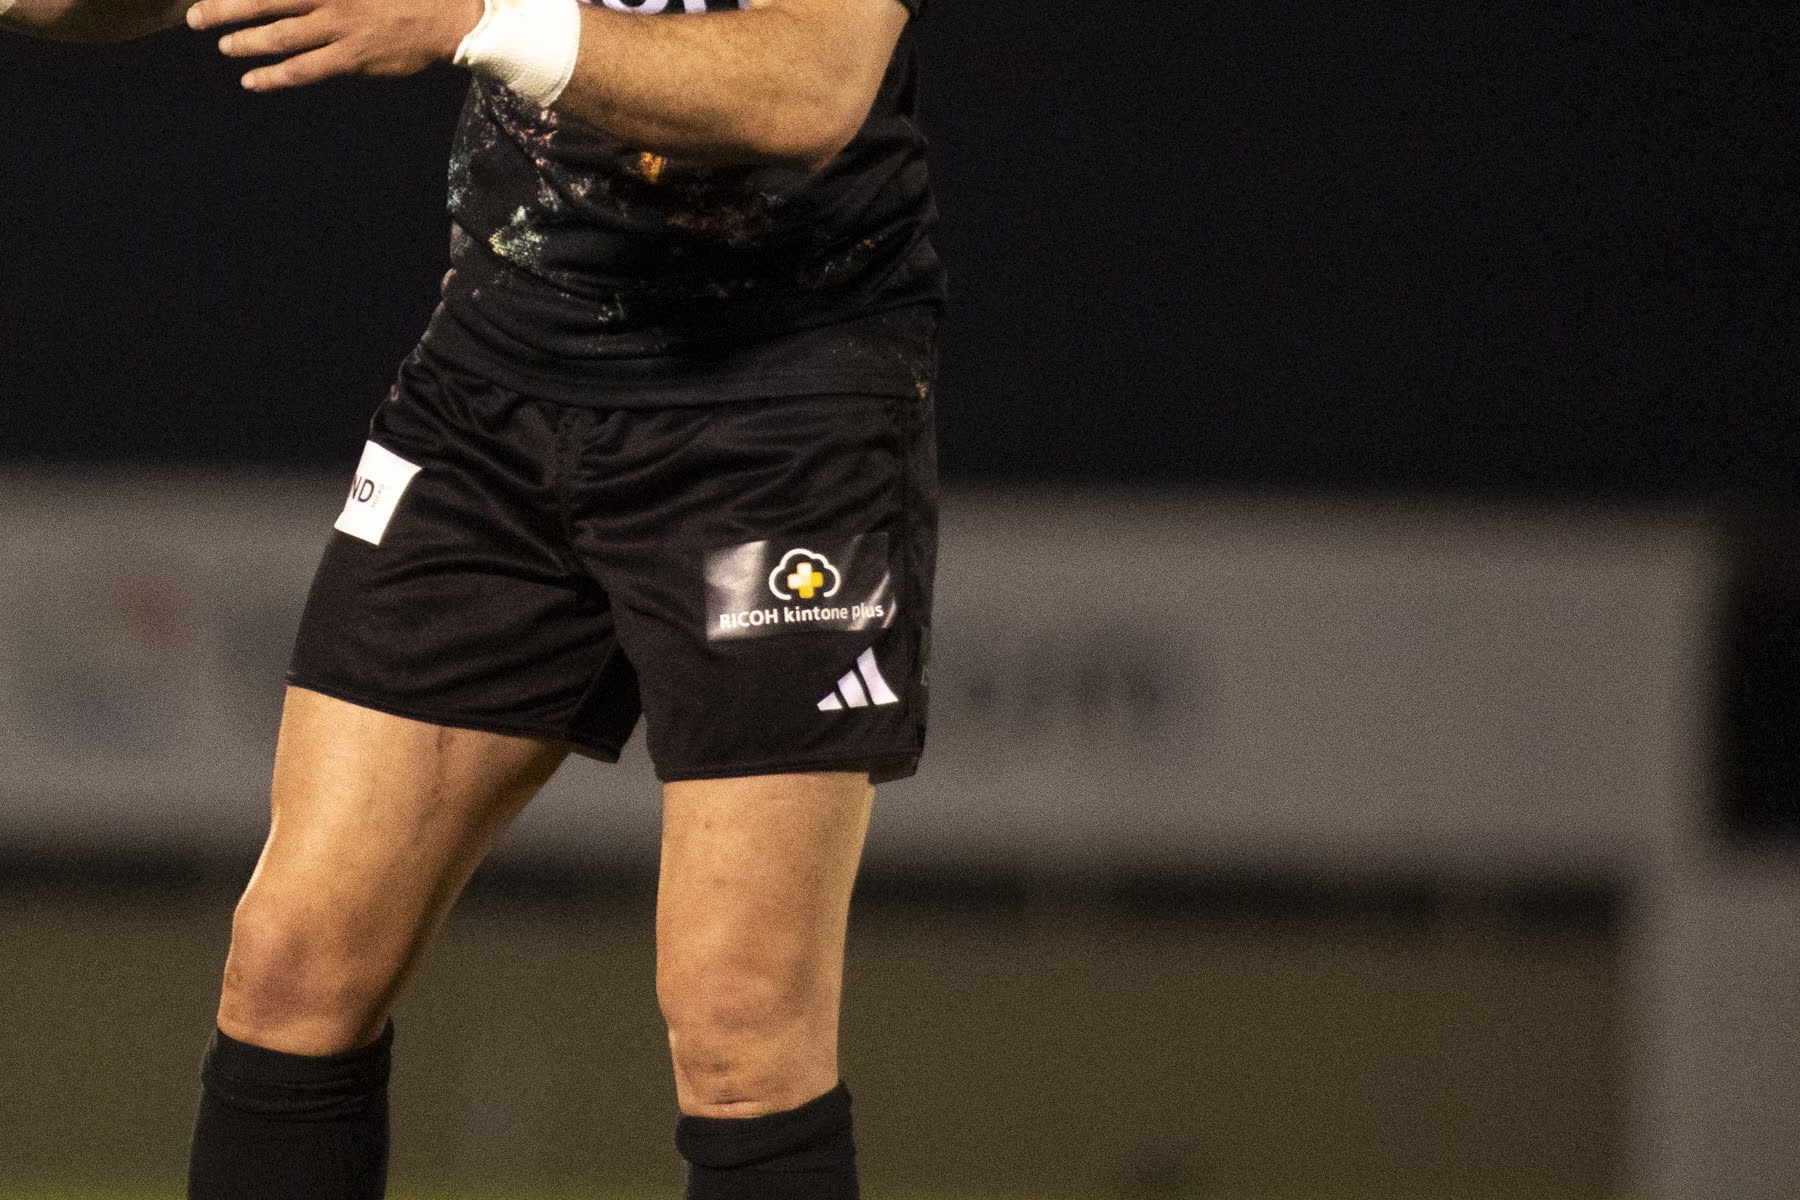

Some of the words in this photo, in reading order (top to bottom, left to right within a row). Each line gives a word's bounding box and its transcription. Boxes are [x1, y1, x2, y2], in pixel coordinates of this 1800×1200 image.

[719, 608, 779, 630] RICOH
[783, 605, 849, 624] kintone
[851, 602, 884, 625] plus
